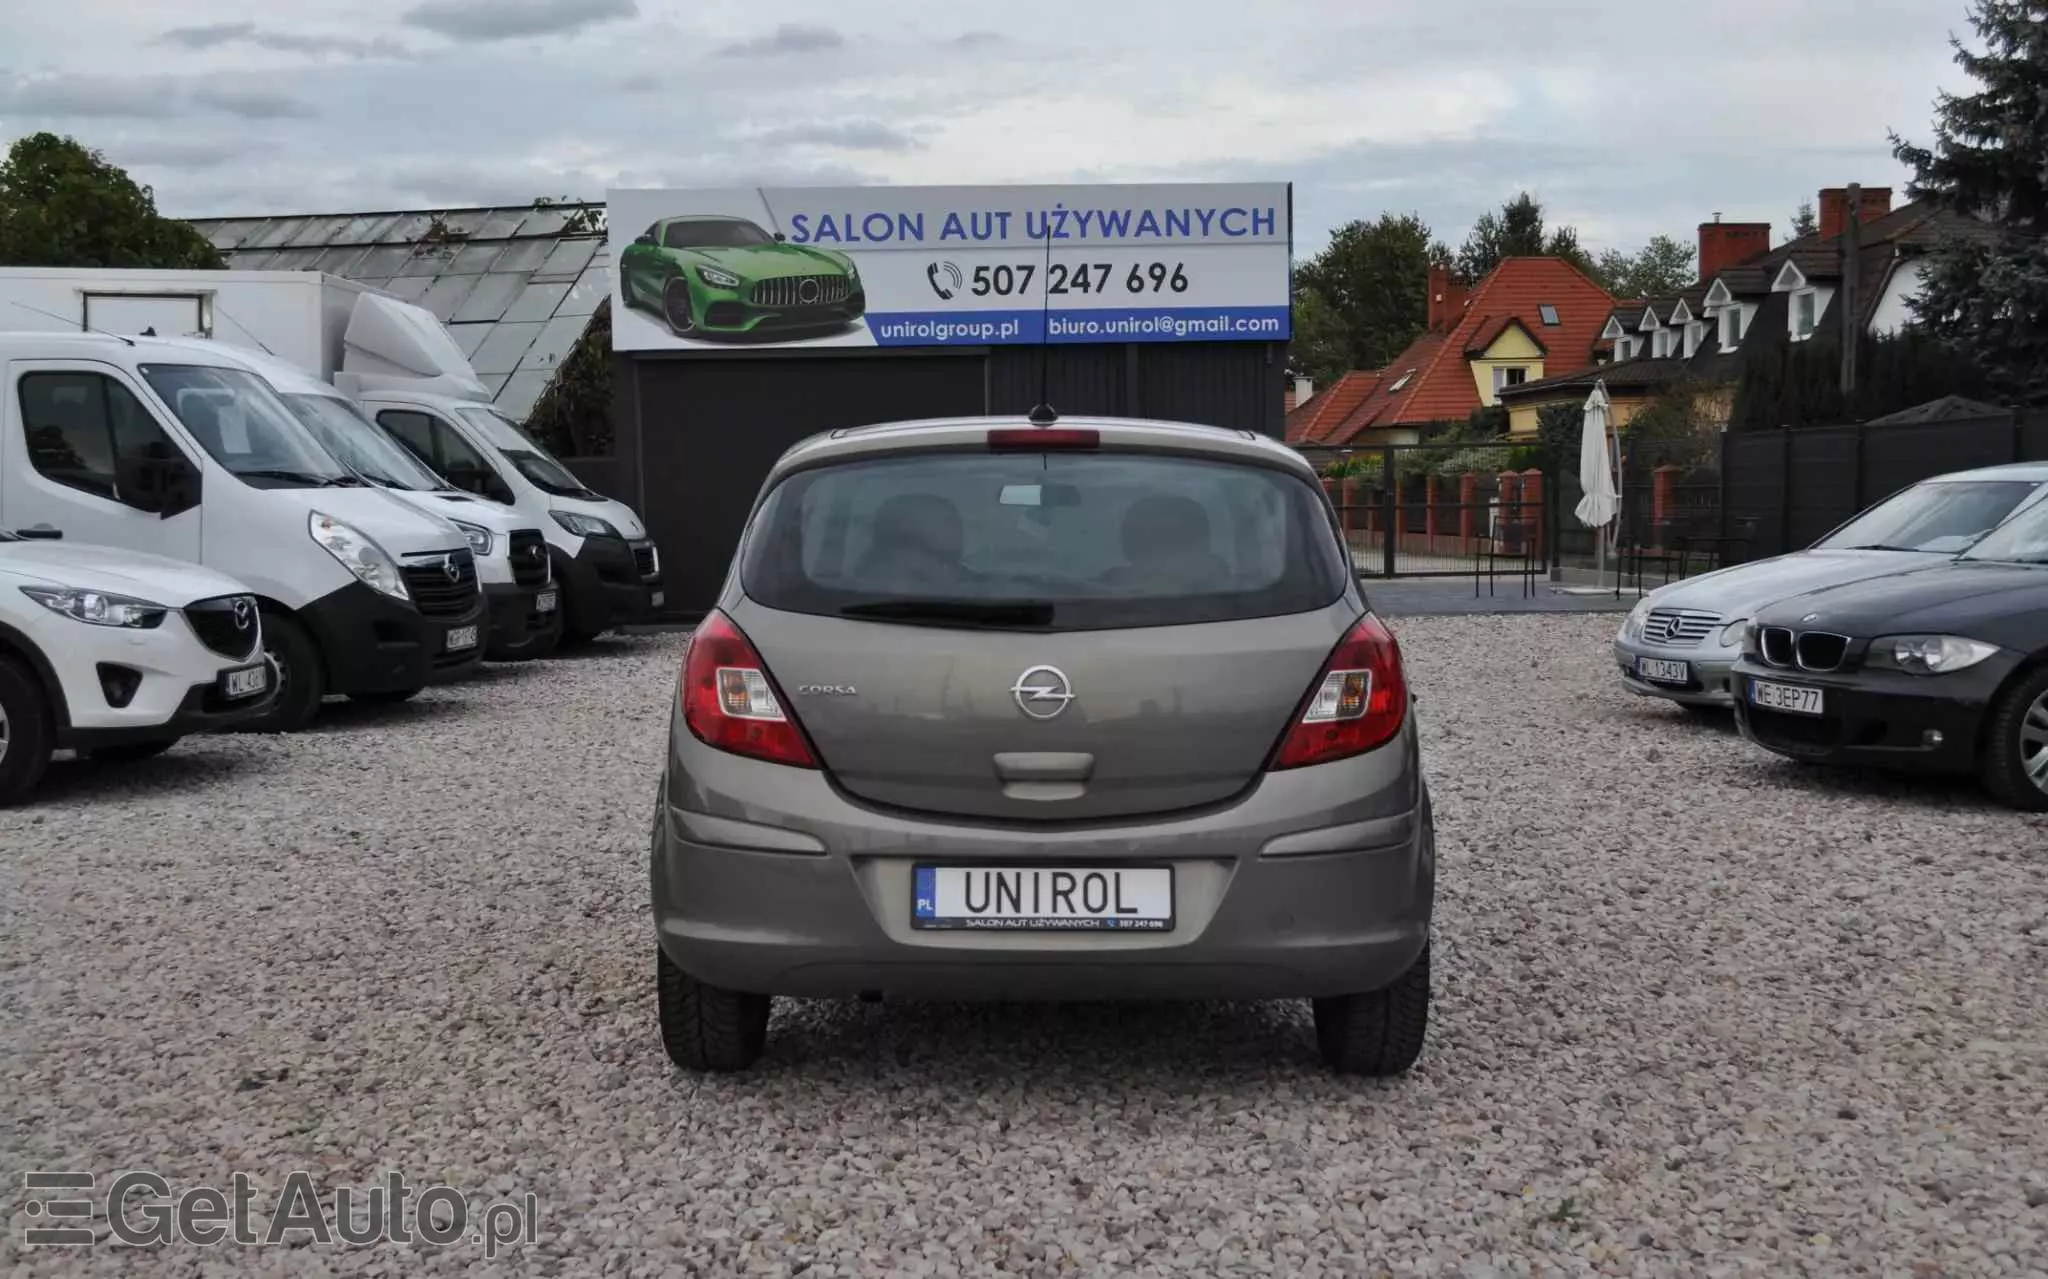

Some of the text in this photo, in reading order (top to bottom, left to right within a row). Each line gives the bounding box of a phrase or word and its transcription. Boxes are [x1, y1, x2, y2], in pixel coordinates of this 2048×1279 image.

[791, 203, 1275, 243] SALON AUT UŻYWANYCH
[971, 262, 1189, 296] 507 247 696
[880, 318, 1020, 342] unirolgroup.pl
[1049, 314, 1280, 337] biuro.unirol@gmail.com
[799, 685, 857, 696] CORSA
[1775, 686, 1819, 711] 3EP77
[964, 871, 1138, 914] UNIROL
[917, 899, 933, 911] PL
[965, 919, 1003, 928] SALON
[1004, 919, 1028, 928] AUT
